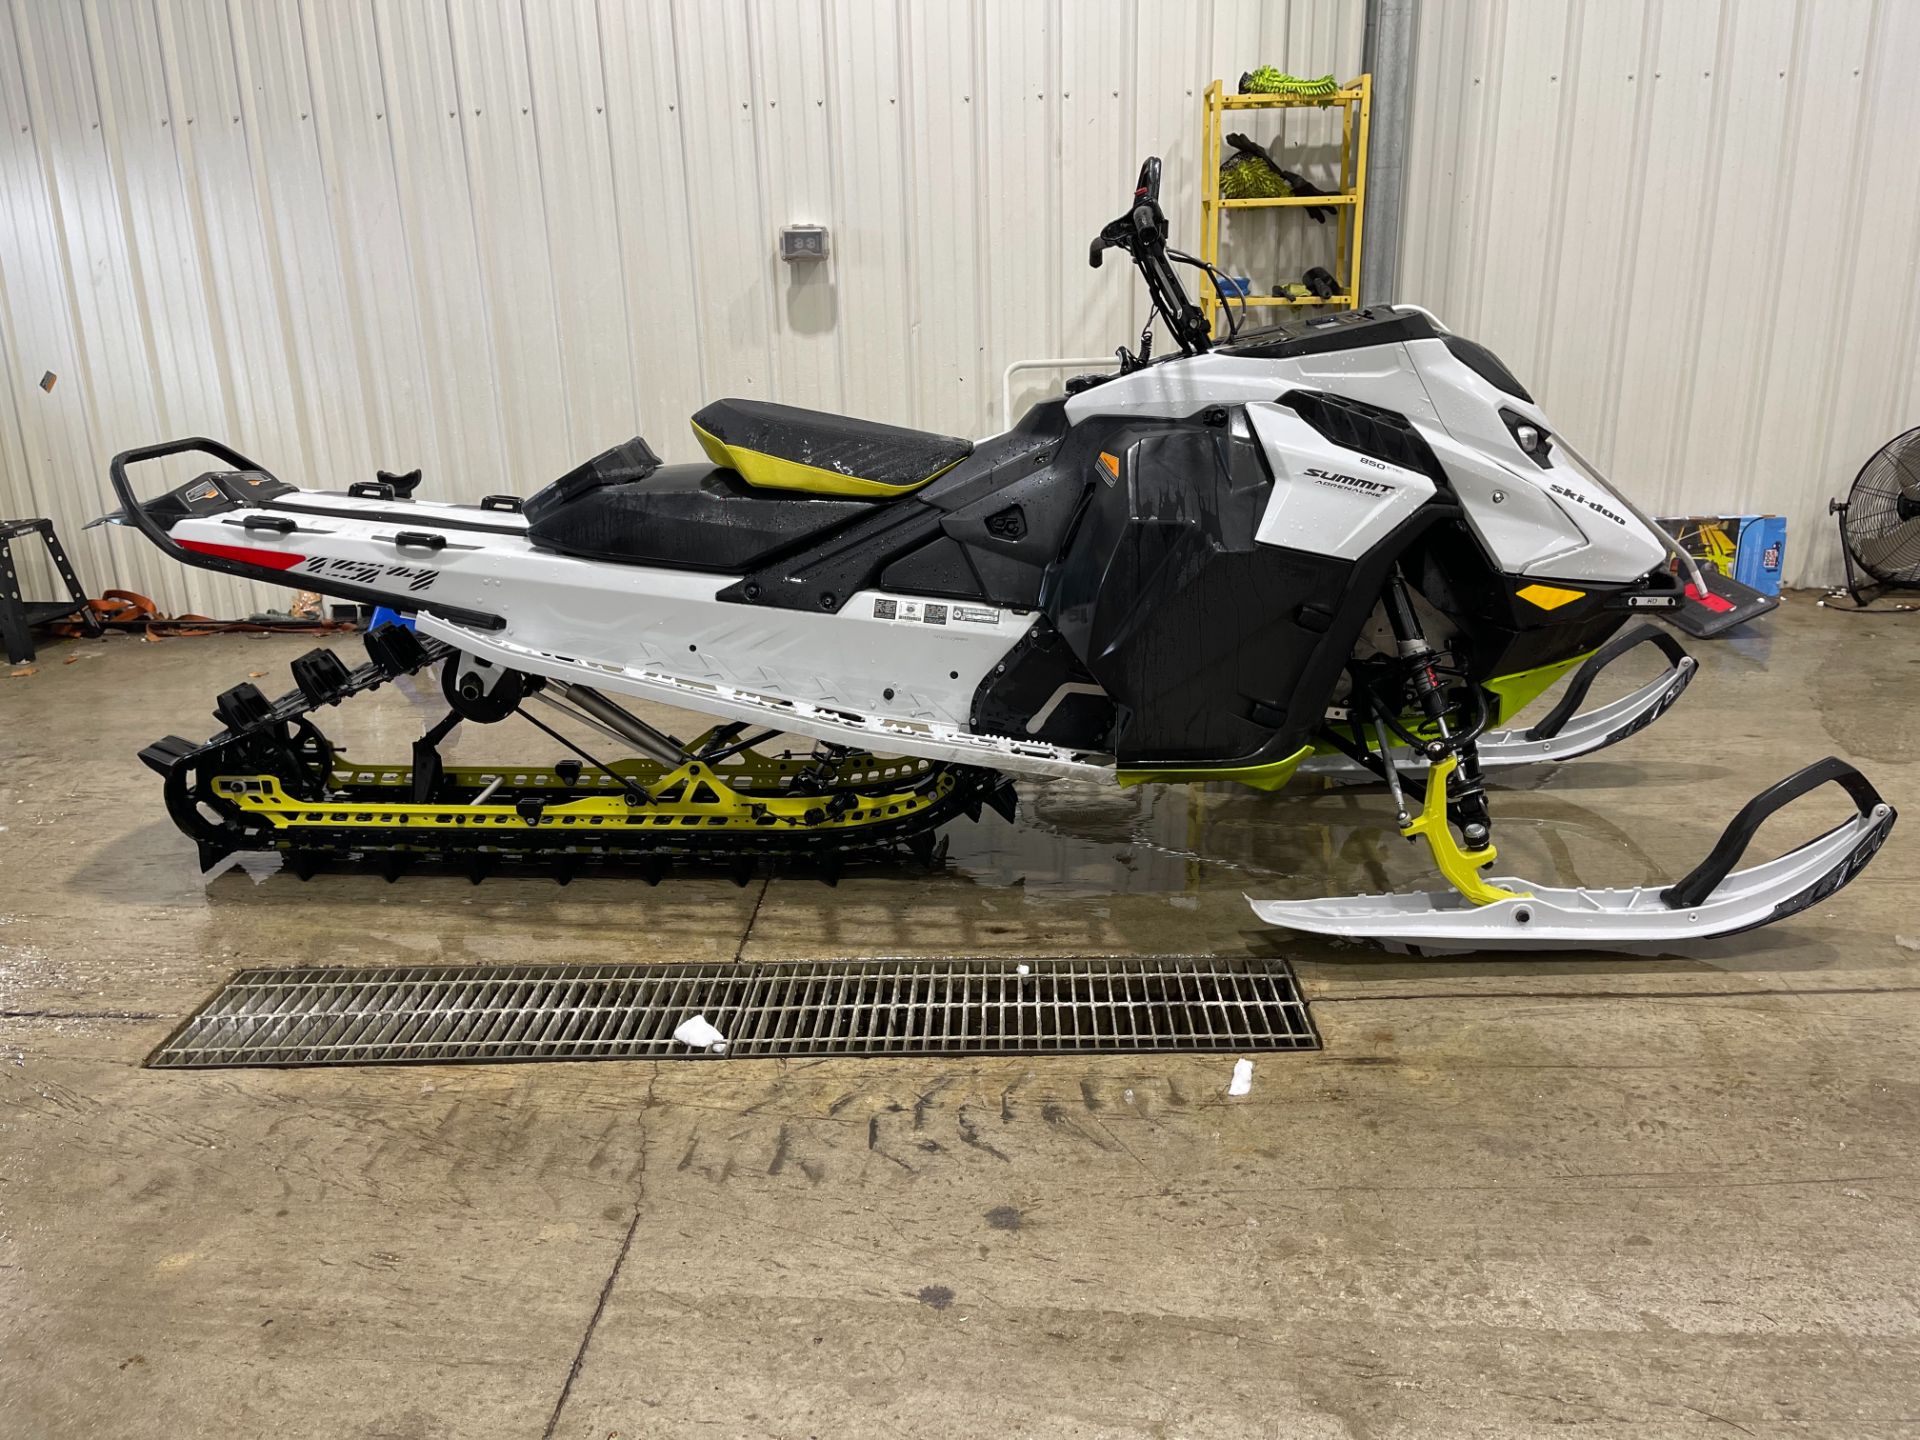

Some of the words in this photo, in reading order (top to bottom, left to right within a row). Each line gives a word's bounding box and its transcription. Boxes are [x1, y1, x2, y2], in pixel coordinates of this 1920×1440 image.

[1360, 457, 1386, 470] 850
[1303, 468, 1396, 492] SUMMIT
[1314, 480, 1382, 498] ADRENALINE
[1549, 484, 1626, 525] ski-doo
